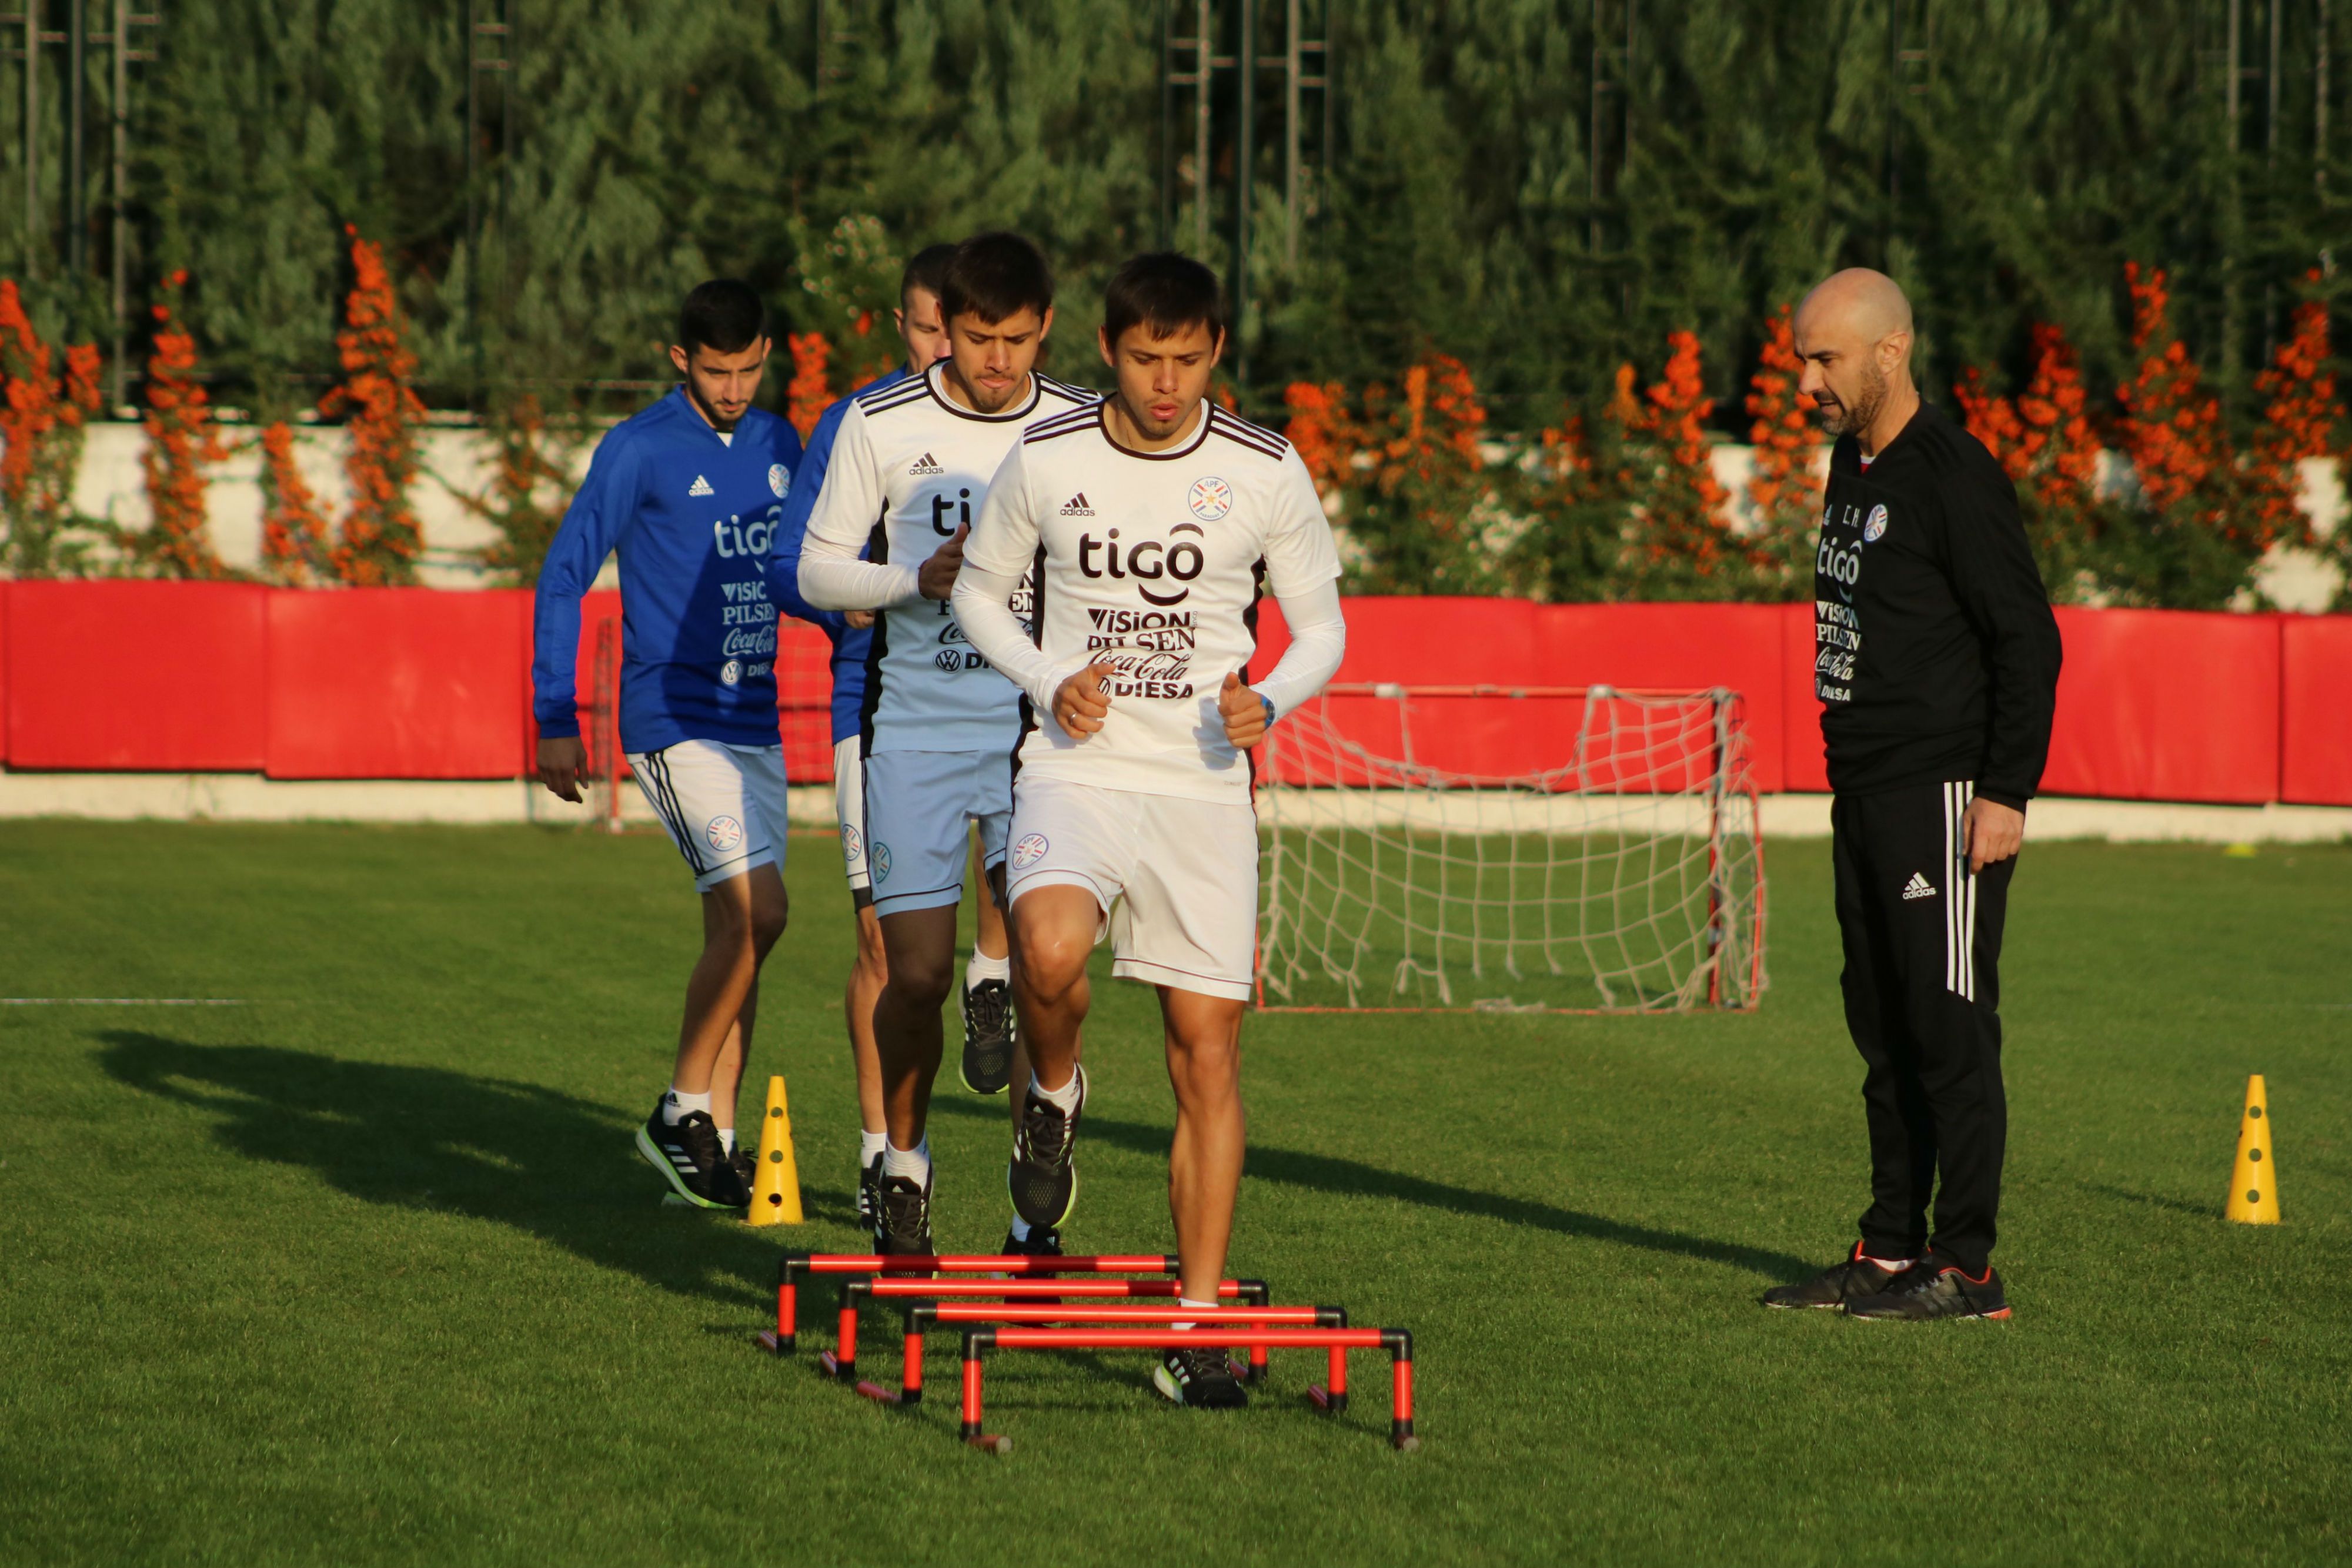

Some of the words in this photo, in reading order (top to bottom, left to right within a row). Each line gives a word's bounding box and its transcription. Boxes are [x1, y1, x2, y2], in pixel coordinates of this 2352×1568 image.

[909, 466, 944, 475] adidas
[689, 487, 714, 496] adidas
[932, 488, 971, 536] ti
[1060, 507, 1095, 516] adidas
[1088, 648, 1194, 681] Coca-Cola
[1115, 681, 1193, 699] DIESA
[1902, 887, 1936, 900] adidas
